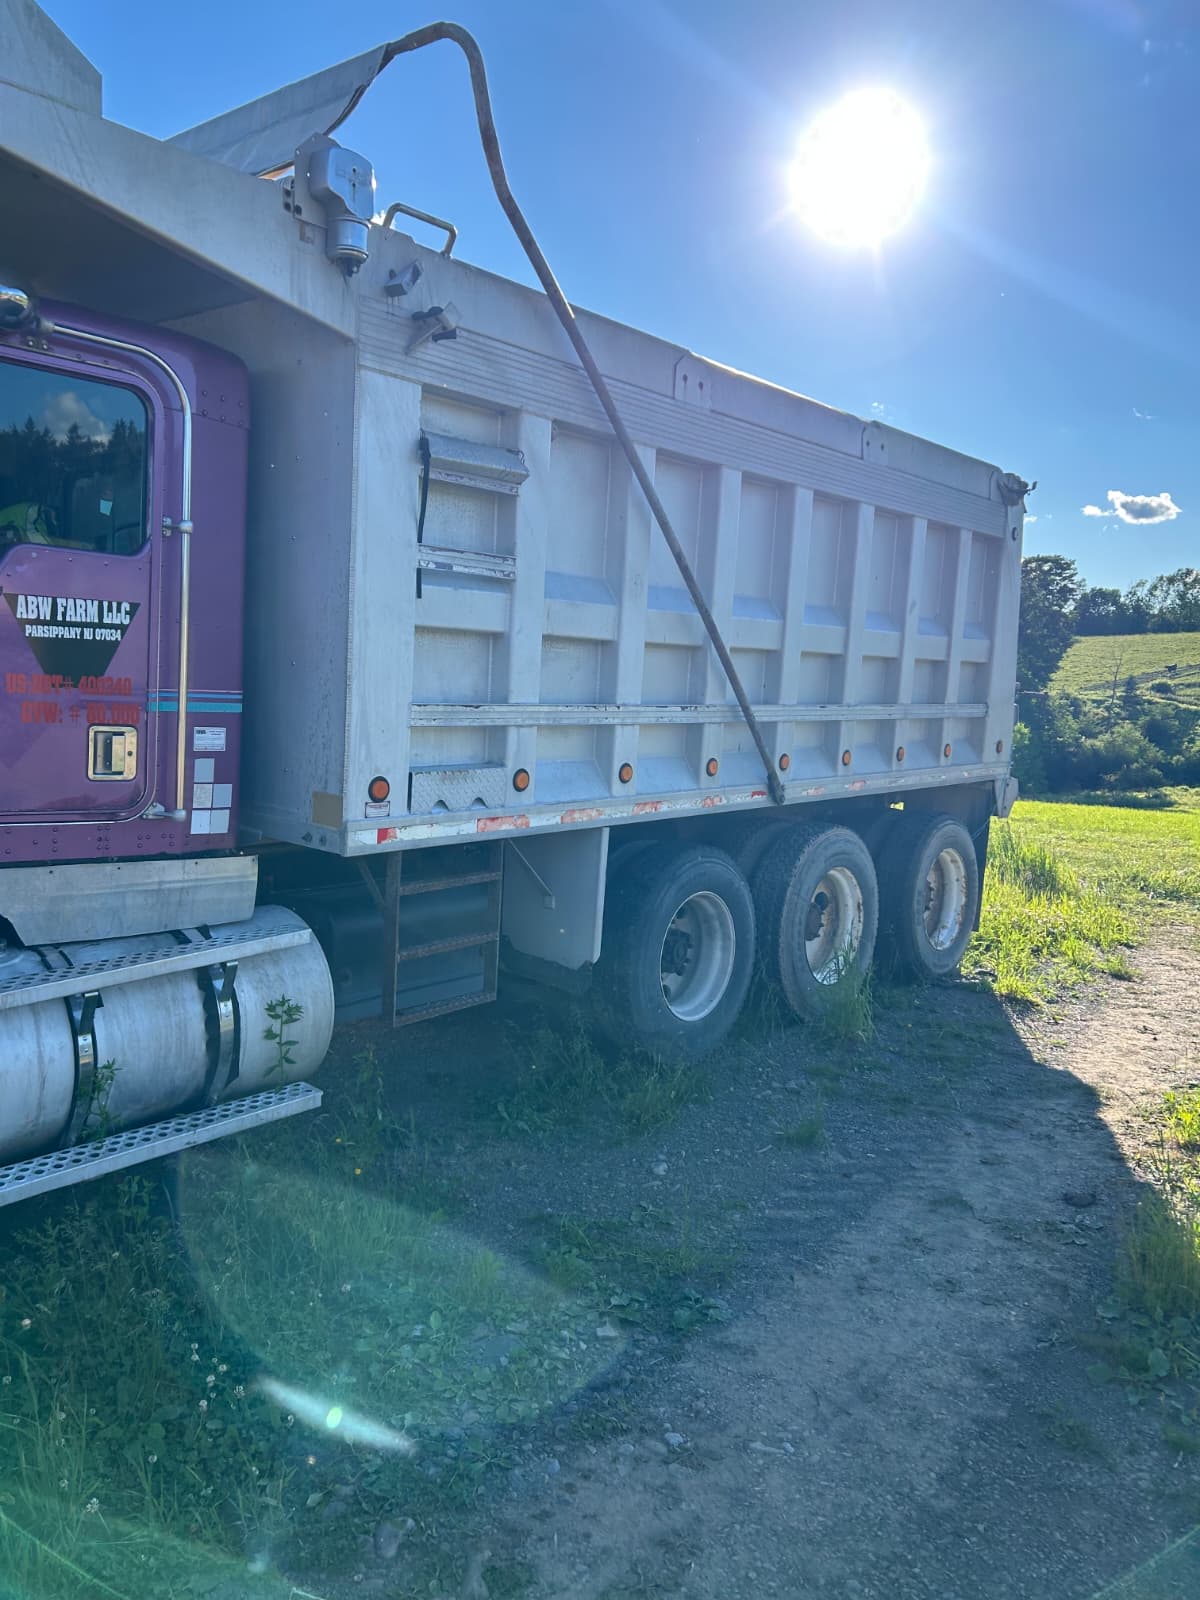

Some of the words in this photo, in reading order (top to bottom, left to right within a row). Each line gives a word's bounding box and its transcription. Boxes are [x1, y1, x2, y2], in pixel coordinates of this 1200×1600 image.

[16, 594, 53, 620] ABW
[56, 597, 99, 623] FARM
[102, 600, 130, 625] LLC
[25, 624, 81, 639] PARSIPPANY
[83, 627, 93, 640] NJ
[95, 628, 122, 641] 07034
